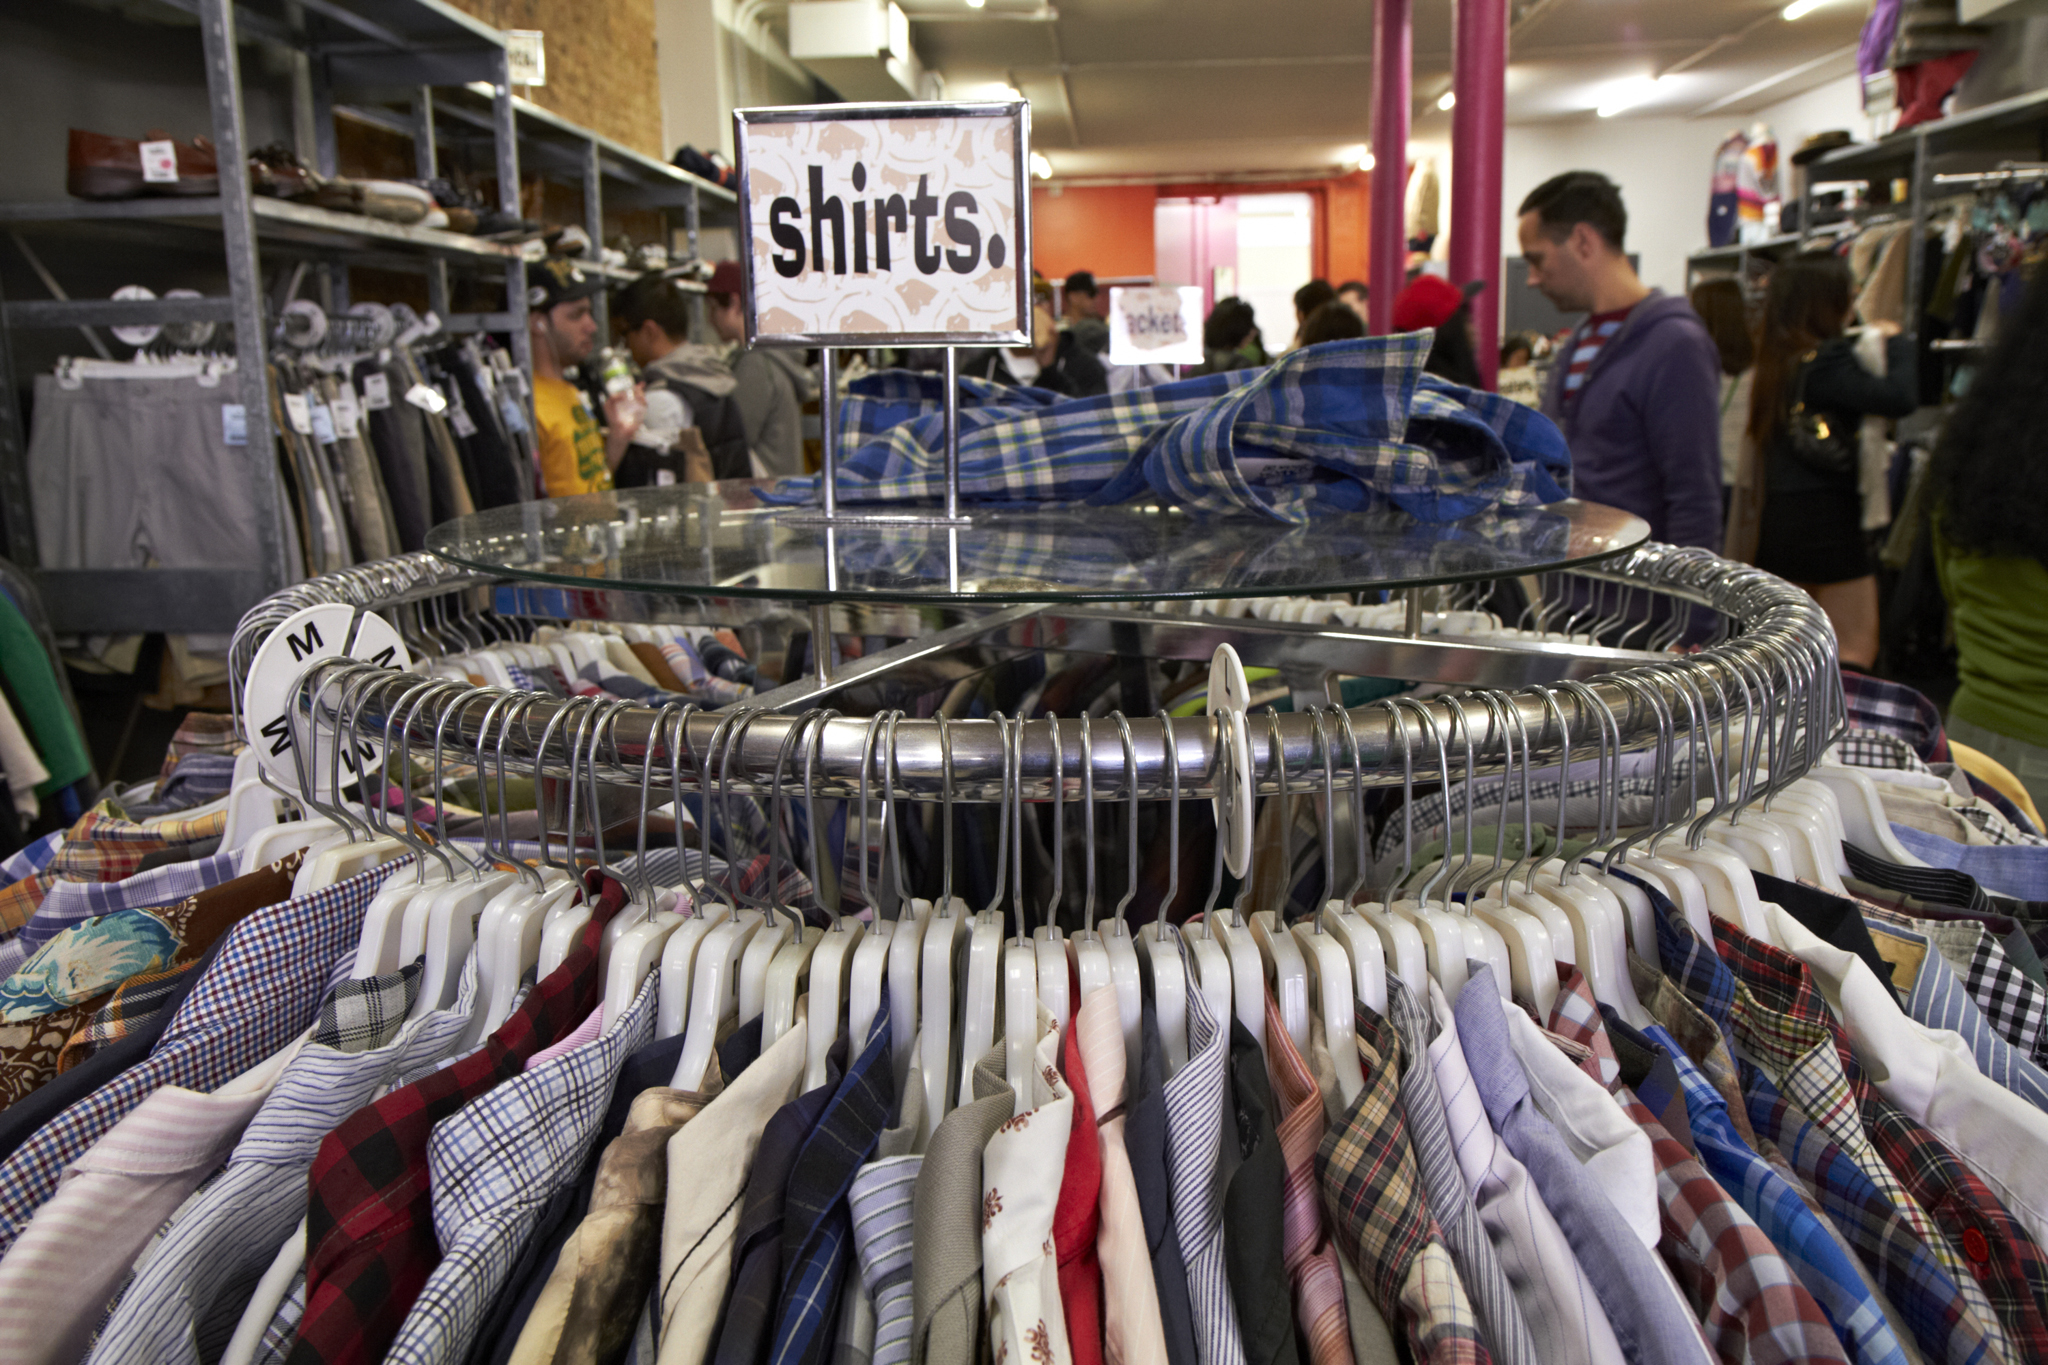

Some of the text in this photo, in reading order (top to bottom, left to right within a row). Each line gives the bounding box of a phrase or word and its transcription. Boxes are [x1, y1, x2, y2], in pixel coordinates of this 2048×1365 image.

[769, 161, 1006, 278] shirts.
[1118, 305, 1187, 334] acket
[286, 621, 324, 662] M
[1225, 656, 1231, 696] L
